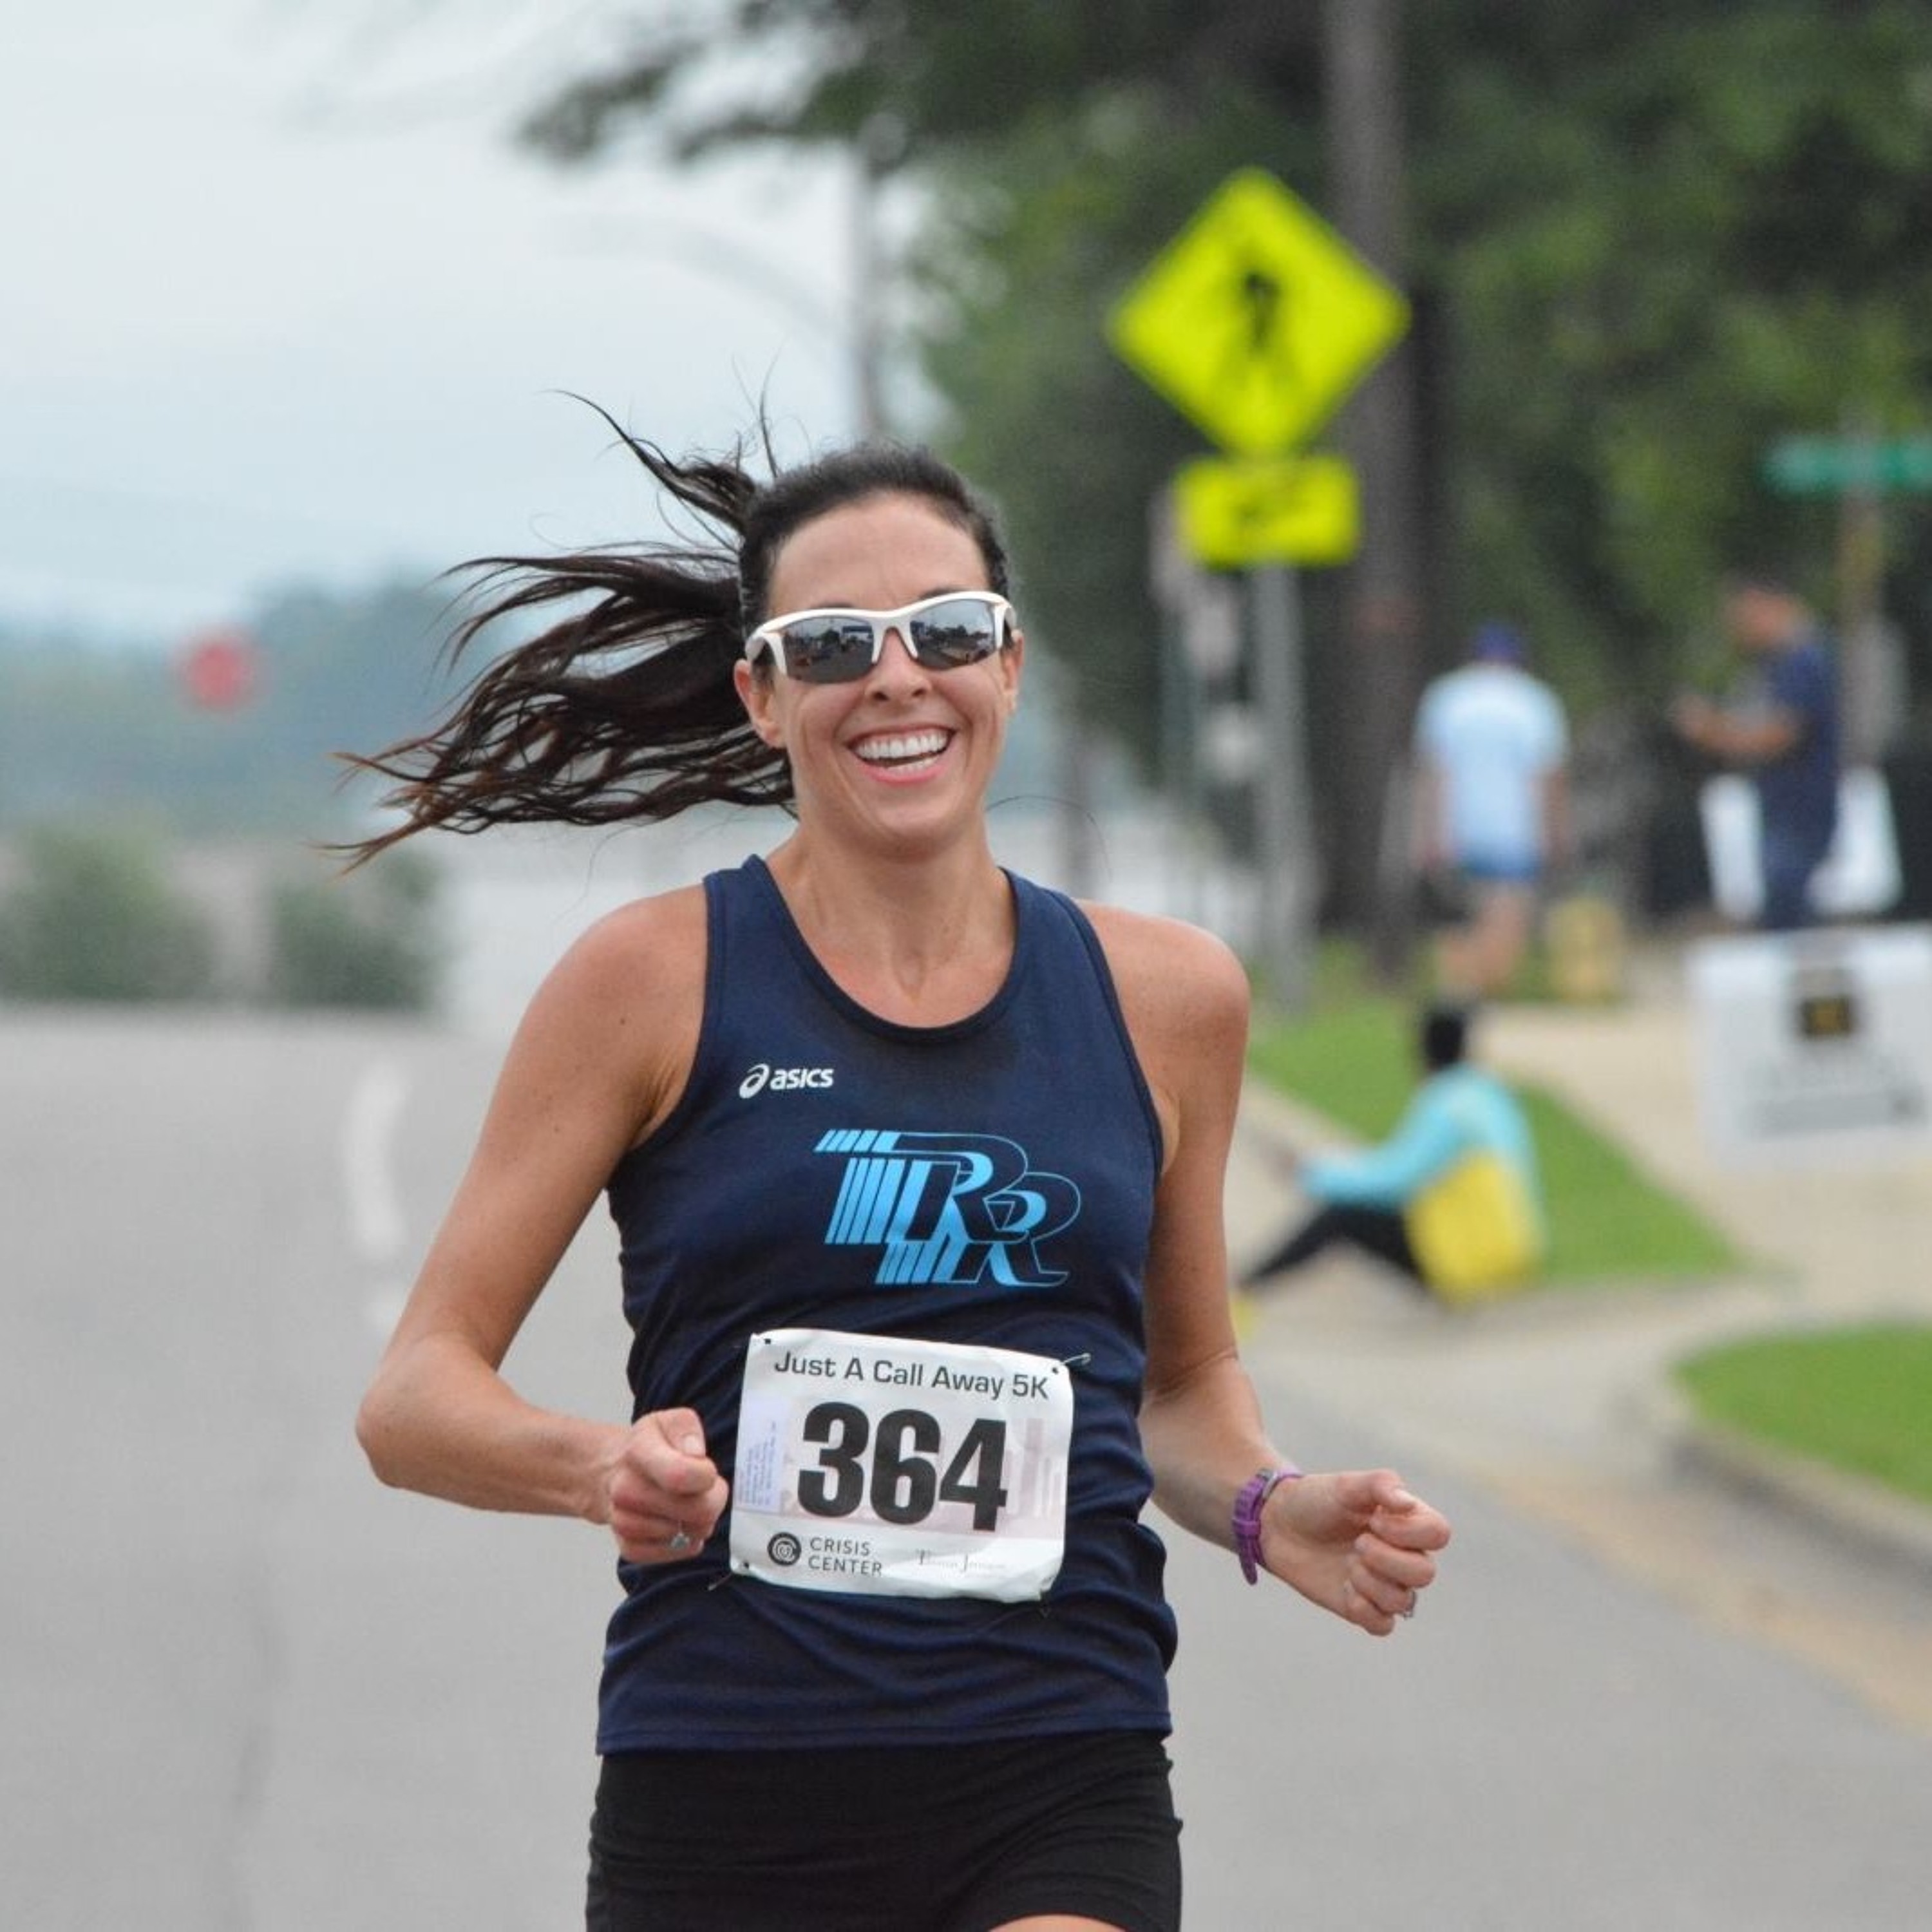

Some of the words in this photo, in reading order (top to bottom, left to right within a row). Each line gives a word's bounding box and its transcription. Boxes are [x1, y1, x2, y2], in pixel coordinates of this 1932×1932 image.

[770, 1067, 835, 1090] asics
[774, 1352, 836, 1377] Just
[844, 1358, 864, 1381] A
[873, 1360, 924, 1387] Call
[931, 1366, 1004, 1400] Away
[1012, 1374, 1049, 1399] 5K
[797, 1402, 1008, 1531] 364
[810, 1537, 871, 1556] CRISIS
[808, 1555, 882, 1577] CENTER
